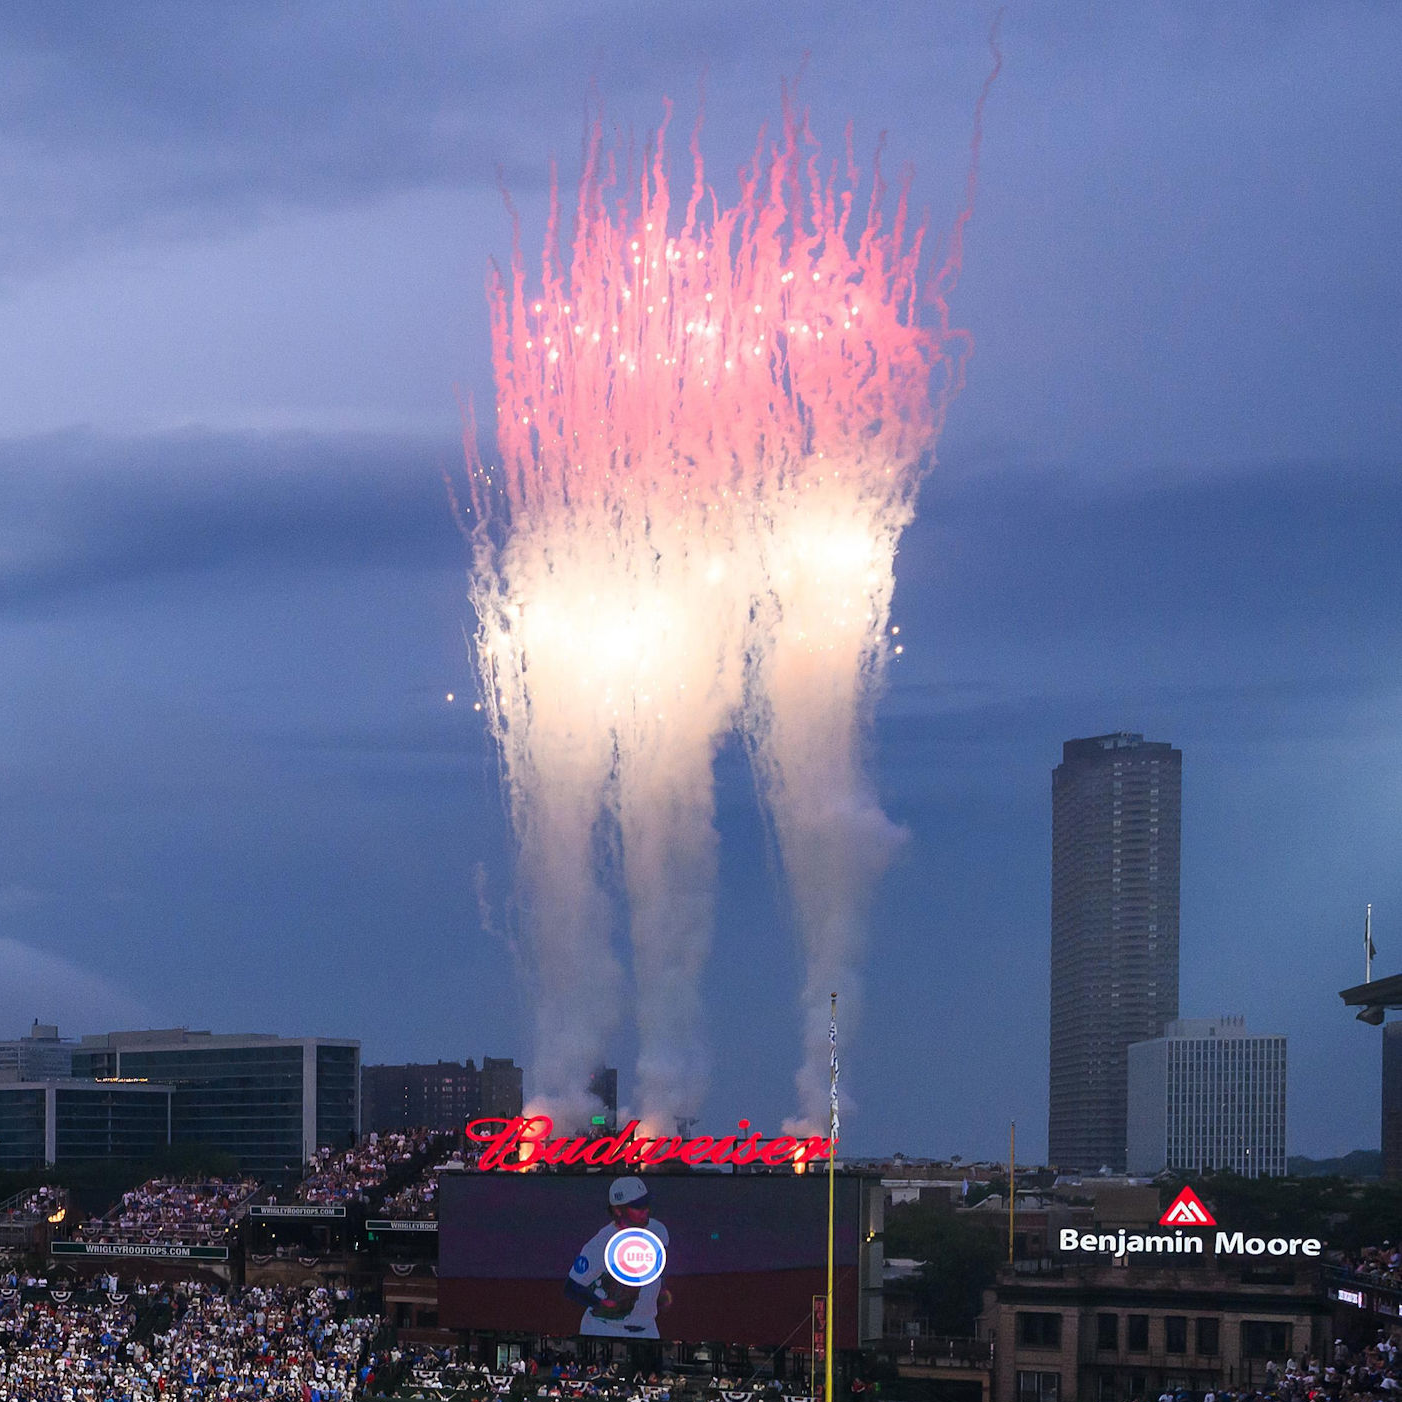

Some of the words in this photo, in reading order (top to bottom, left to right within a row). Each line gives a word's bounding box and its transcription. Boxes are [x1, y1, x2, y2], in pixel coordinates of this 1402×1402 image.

[465, 1115, 837, 1171] Budweiser
[261, 1207, 335, 1216] WRIGLEYROOFTOPS.COM
[391, 1221, 438, 1230] WRIGLEYROOF
[85, 1243, 191, 1257] WRIGLEYROOFTOPS.COM
[1059, 1229, 1203, 1258] Benjamin
[1215, 1232, 1322, 1257] Moore
